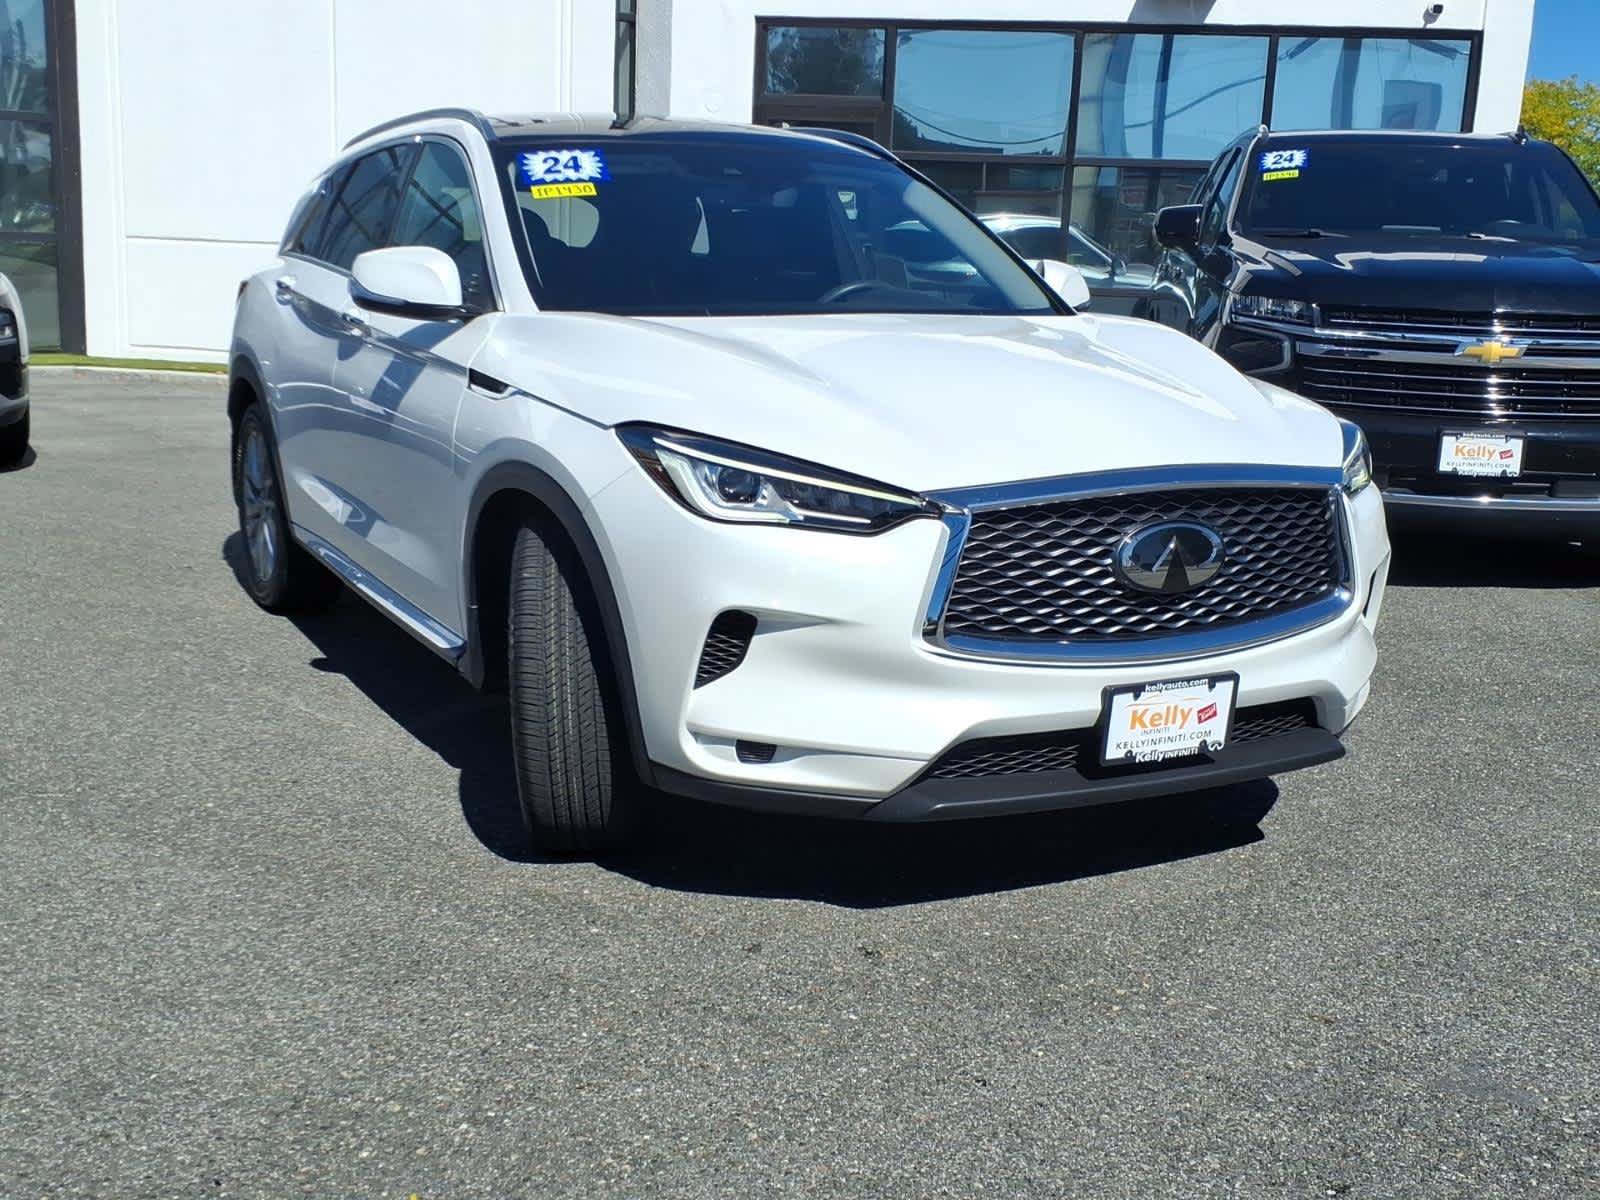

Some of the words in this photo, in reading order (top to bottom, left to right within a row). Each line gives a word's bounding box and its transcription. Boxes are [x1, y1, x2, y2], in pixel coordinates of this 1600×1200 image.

[542, 156, 582, 174] 24
[1271, 153, 1295, 165] 24
[1455, 445, 1496, 461] Kelly
[1145, 679, 1209, 693] kellyauto.com
[1129, 705, 1192, 730] Kelly
[1115, 729, 1212, 750] KELLYINFINITI.COM
